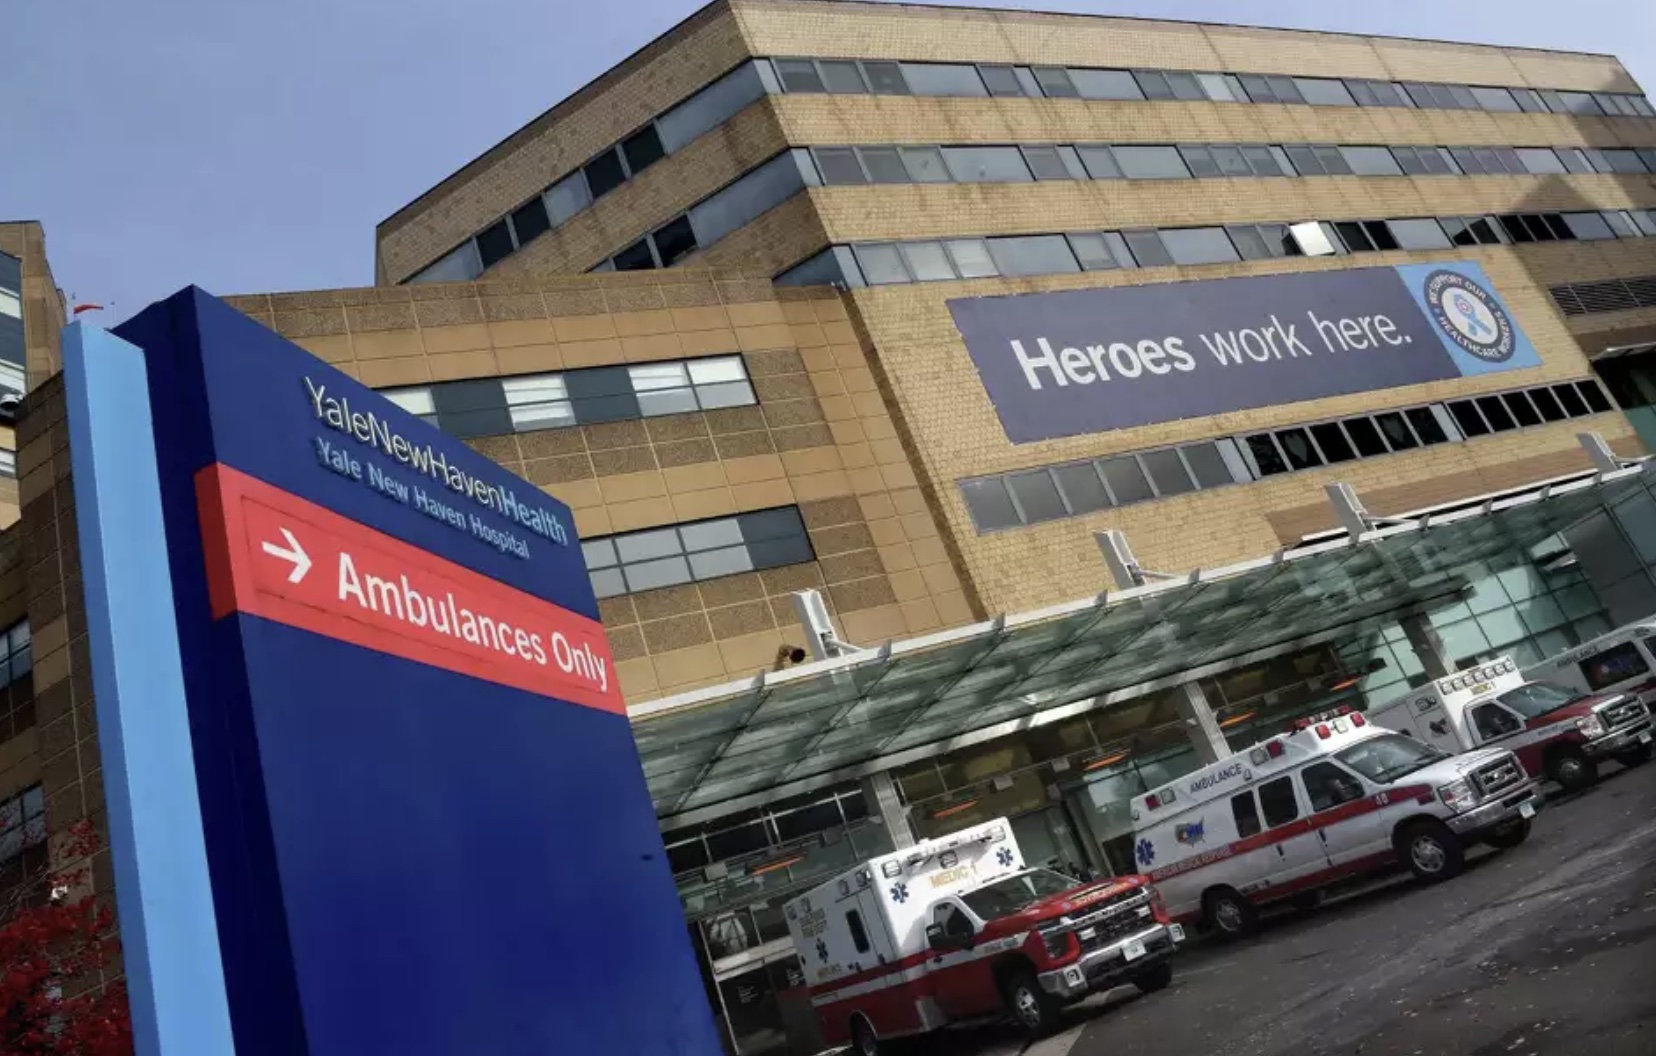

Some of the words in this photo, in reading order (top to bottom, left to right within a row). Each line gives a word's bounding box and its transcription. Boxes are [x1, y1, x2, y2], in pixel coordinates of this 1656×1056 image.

[1465, 281, 1486, 300] OUR
[1010, 337, 1196, 390] Heroes
[1200, 314, 1312, 366] work
[1308, 310, 1413, 354] here.
[1439, 316, 1501, 357] HEALTHCARE
[317, 436, 362, 479] Yale
[367, 462, 409, 501] New
[414, 485, 466, 529] Haven
[469, 513, 530, 559] Hospital
[338, 552, 547, 665] Ambulances
[552, 631, 608, 691] Only
[1190, 763, 1242, 794] AMBULANCE
